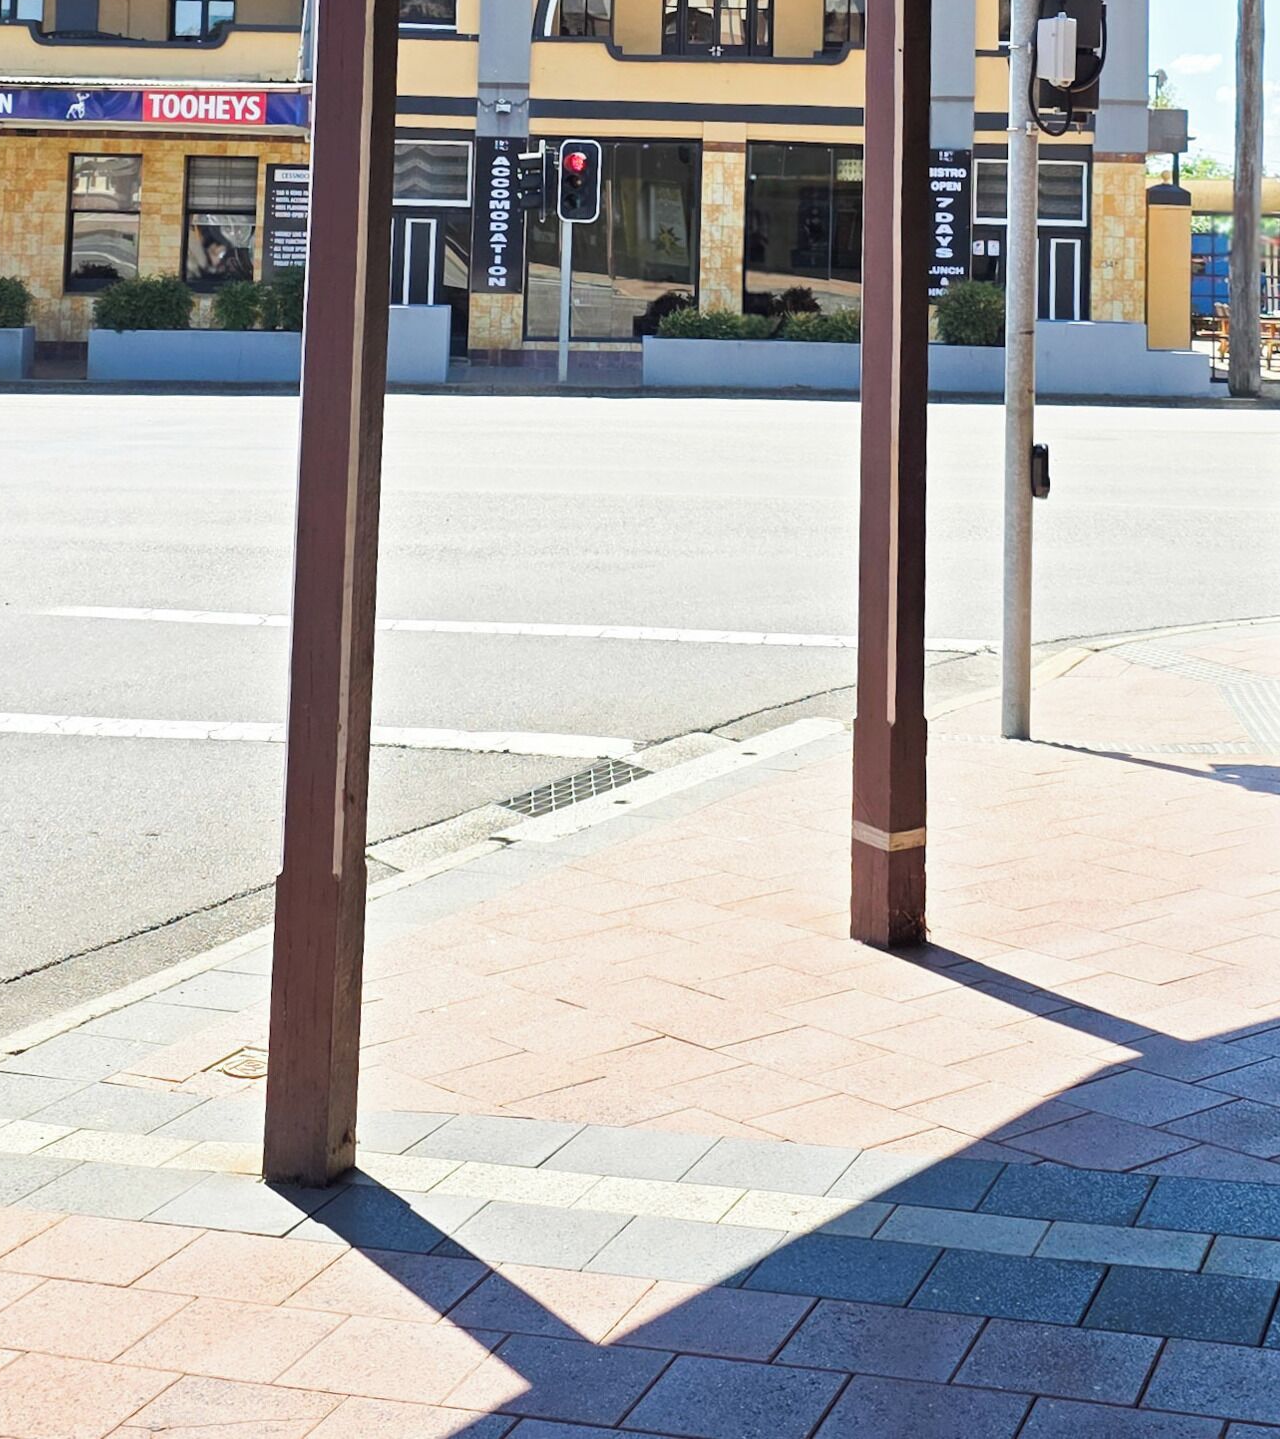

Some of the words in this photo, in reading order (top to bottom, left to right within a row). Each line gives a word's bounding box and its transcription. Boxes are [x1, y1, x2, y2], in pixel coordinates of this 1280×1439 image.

[148, 93, 261, 121] TOOHEYS
[930, 180, 962, 191] OPEN
[487, 155, 511, 287] ACCOMODATION
[935, 212, 954, 258] DAYS
